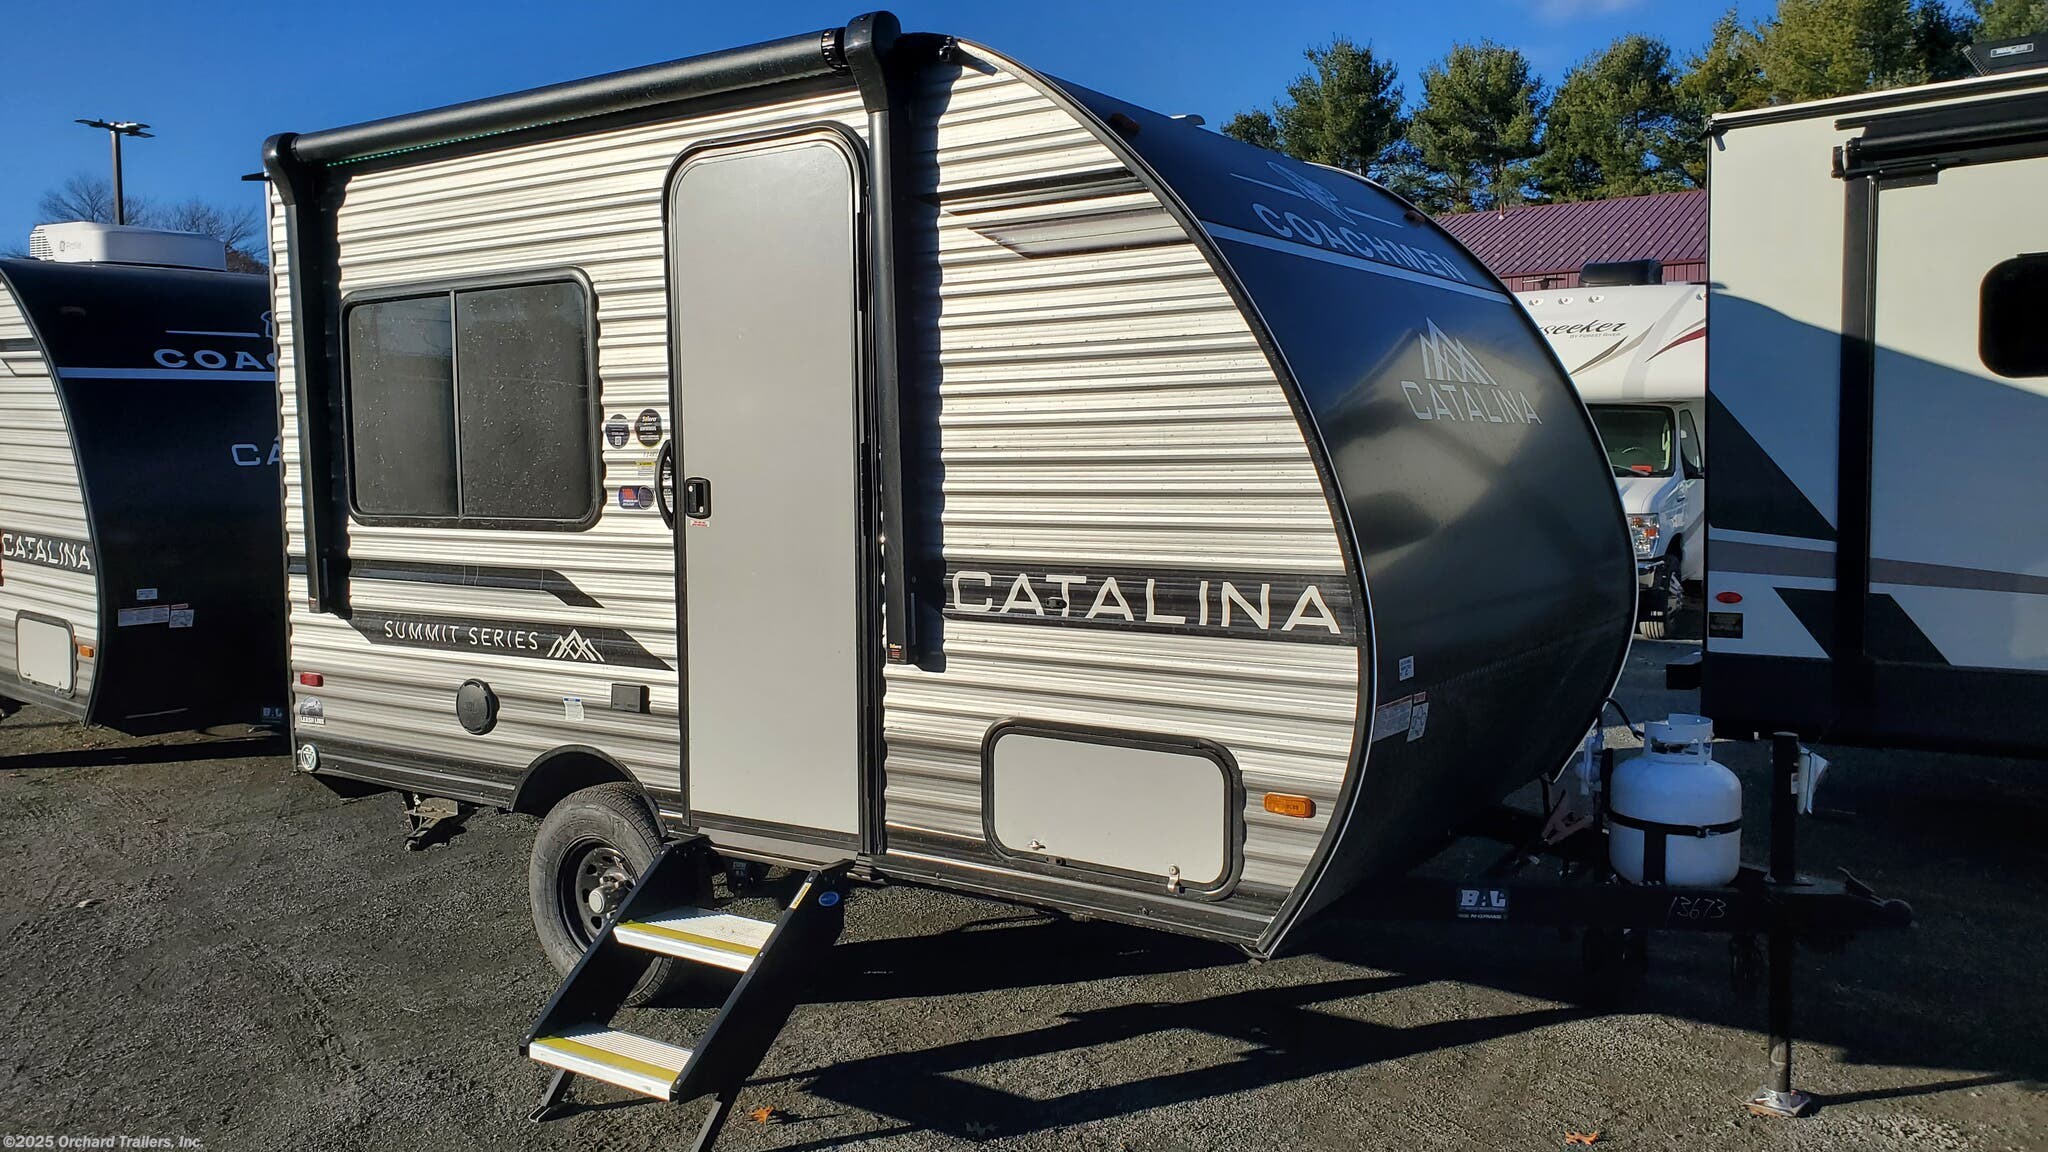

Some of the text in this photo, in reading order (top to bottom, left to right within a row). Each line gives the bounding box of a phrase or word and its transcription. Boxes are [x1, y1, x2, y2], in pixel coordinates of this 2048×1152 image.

[1252, 202, 1468, 282] COACHMEN
[1401, 380, 1543, 425] CATALINA
[1, 533, 91, 570] CATALINA
[952, 570, 1342, 635] CATALINA
[384, 620, 539, 650] SUMMIT SERIES
[1666, 896, 1727, 920] 13673
